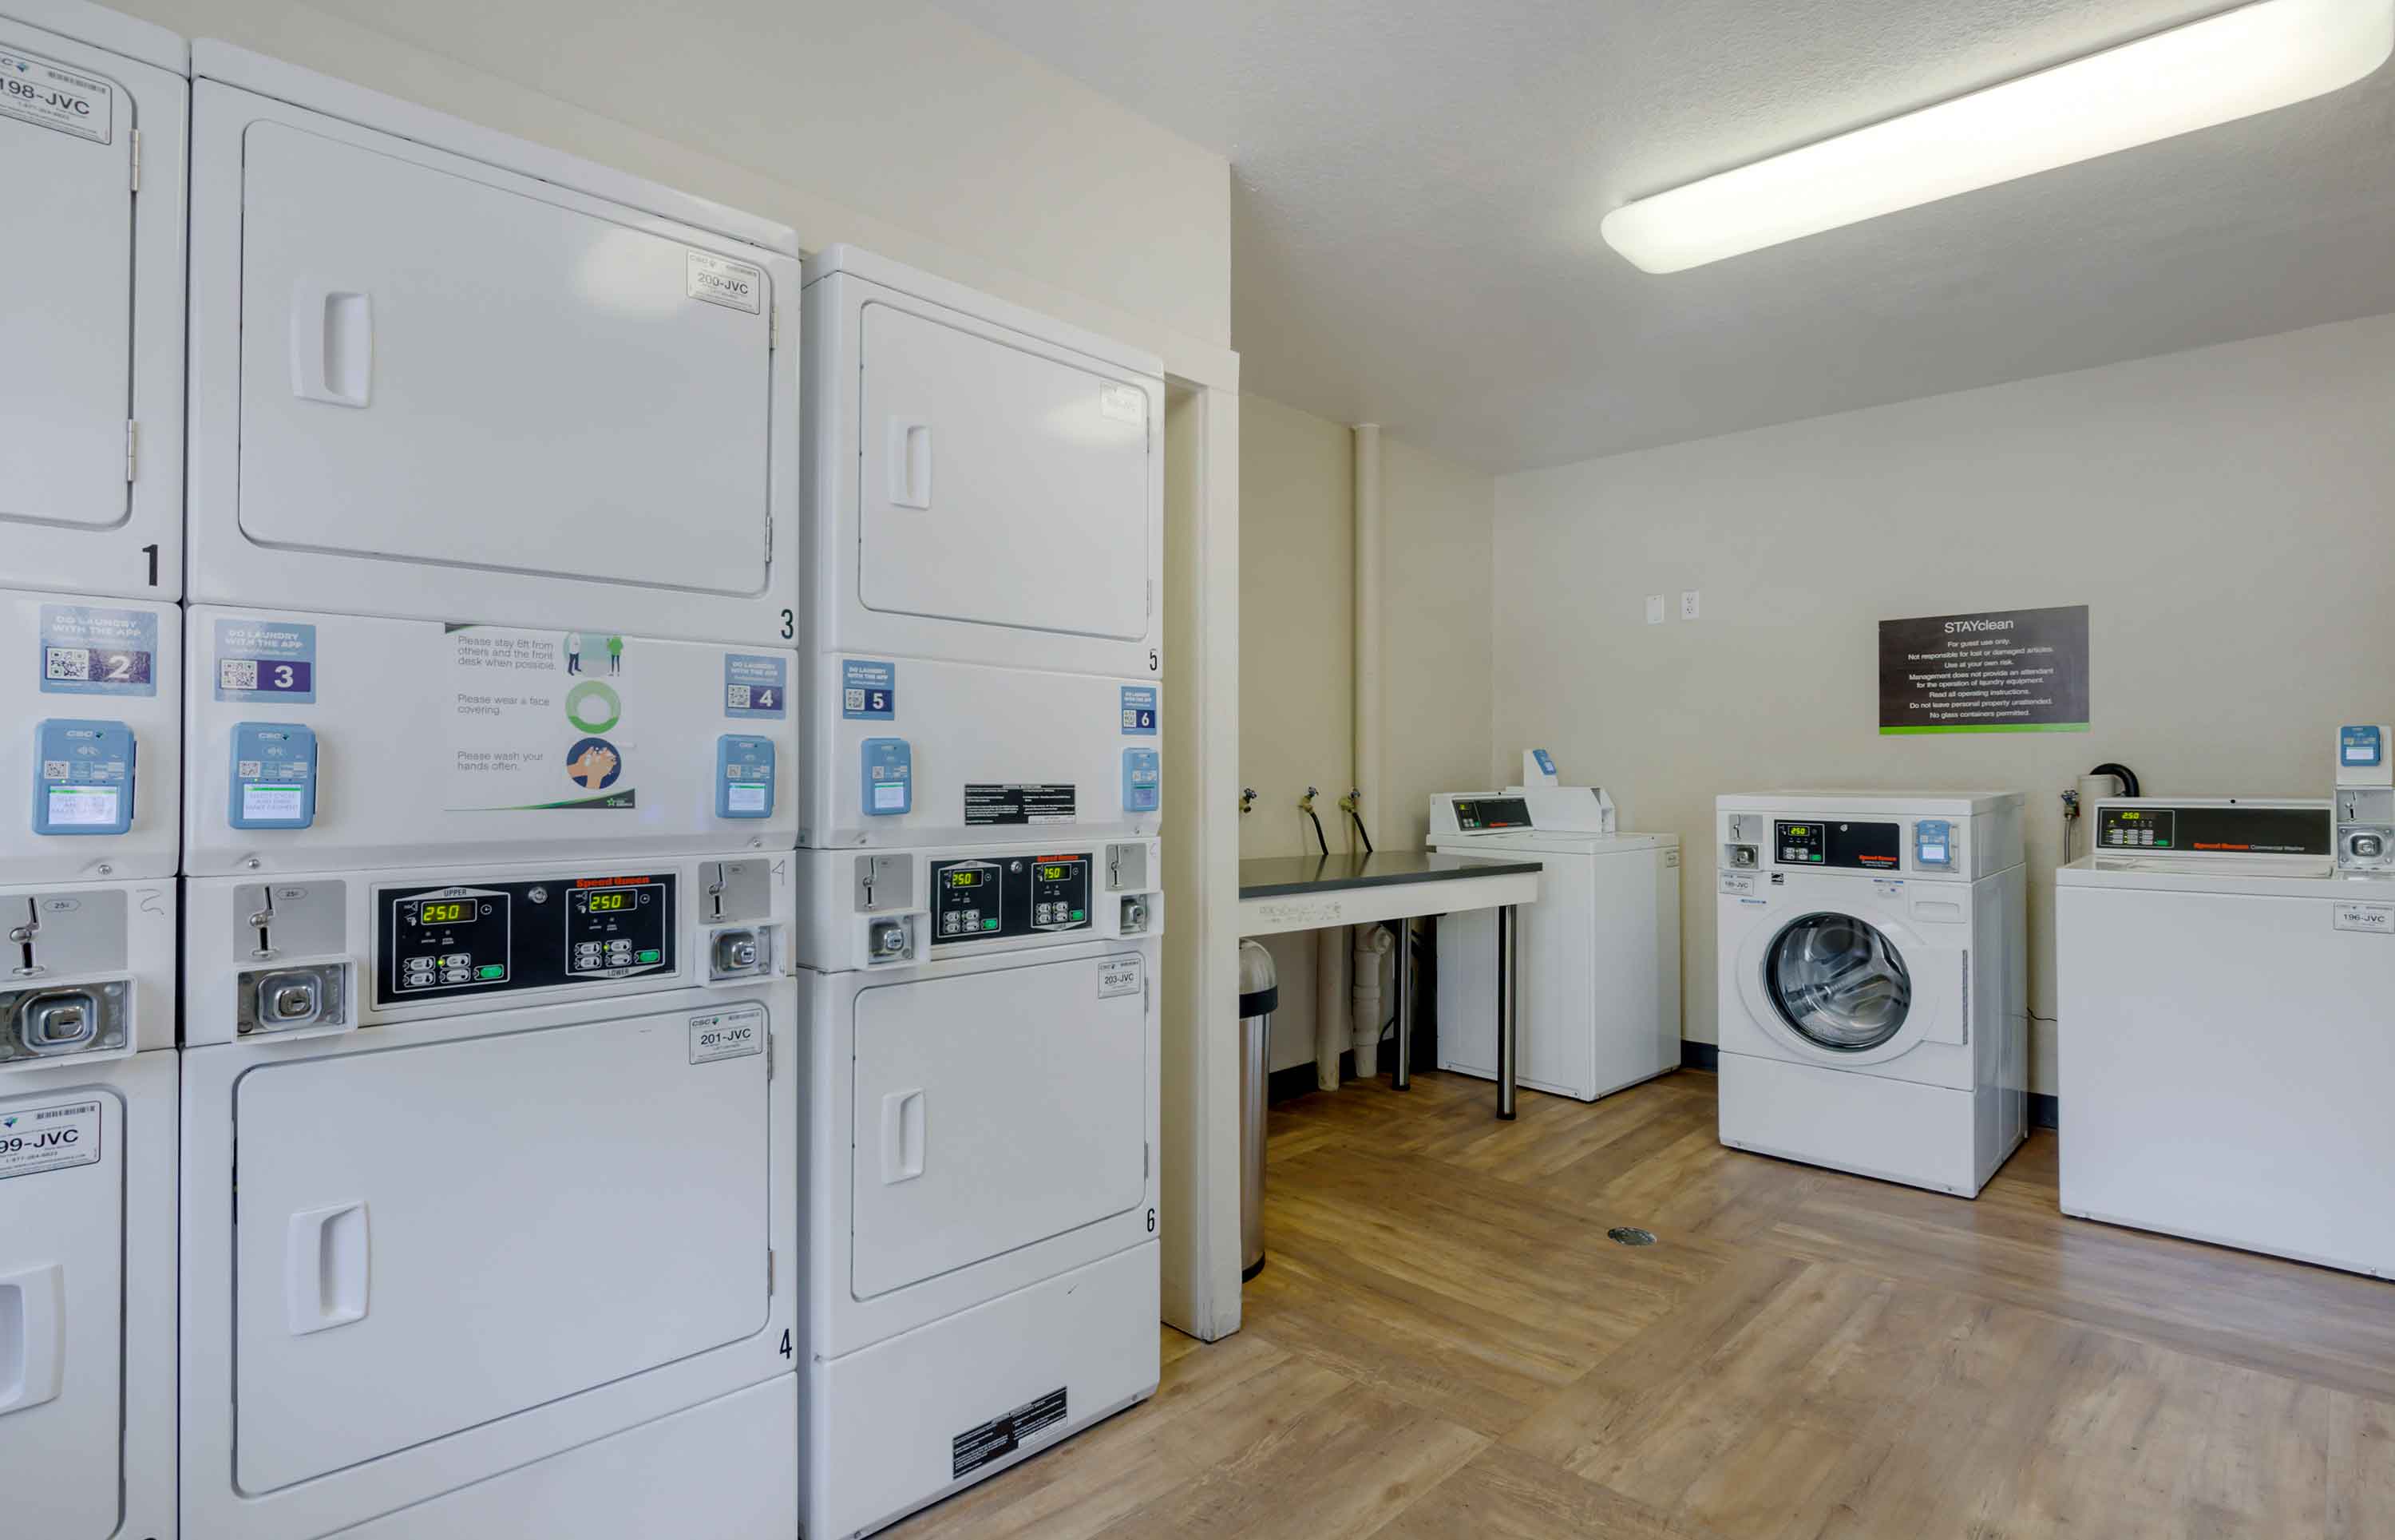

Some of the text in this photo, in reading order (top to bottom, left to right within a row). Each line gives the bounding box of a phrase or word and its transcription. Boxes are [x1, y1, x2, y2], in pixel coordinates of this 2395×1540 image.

[697, 272, 748, 295] 200-JVC
[142, 544, 158, 587] 1
[781, 608, 794, 639] 3
[1944, 619, 2014, 634] STAYclean
[457, 635, 492, 647] Please
[495, 637, 513, 649] stay
[532, 639, 553, 650] from
[457, 647, 553, 660] others and the front
[1149, 648, 1158, 671] 5
[1921, 651, 1958, 661] responsible
[1992, 647, 2025, 656] damaged
[107, 655, 131, 679] 2
[457, 656, 556, 671] desk when possible.
[274, 664, 294, 689] 3
[457, 694, 492, 704] Please
[494, 696, 517, 706] wear
[529, 696, 550, 707] face
[759, 689, 773, 707] 4
[873, 693, 884, 710] 5
[1957, 690, 1989, 699] operating
[1950, 700, 1980, 709] personal
[1981, 699, 2010, 708] property
[1142, 712, 1150, 726] 6
[1941, 711, 1959, 719] glass
[1996, 709, 2031, 718] permitted.
[457, 751, 544, 763] Please wash your
[457, 761, 521, 772] hands often.
[576, 876, 650, 889] Speed Queen
[444, 889, 467, 897] UPPER
[591, 895, 621, 910] 250
[423, 905, 460, 922] 250
[608, 968, 629, 977] LOWER
[1104, 972, 1134, 984] 203-JVC
[700, 1027, 752, 1045] 201-JVC
[1146, 1208, 1155, 1233] 6
[779, 1328, 793, 1360] 4
